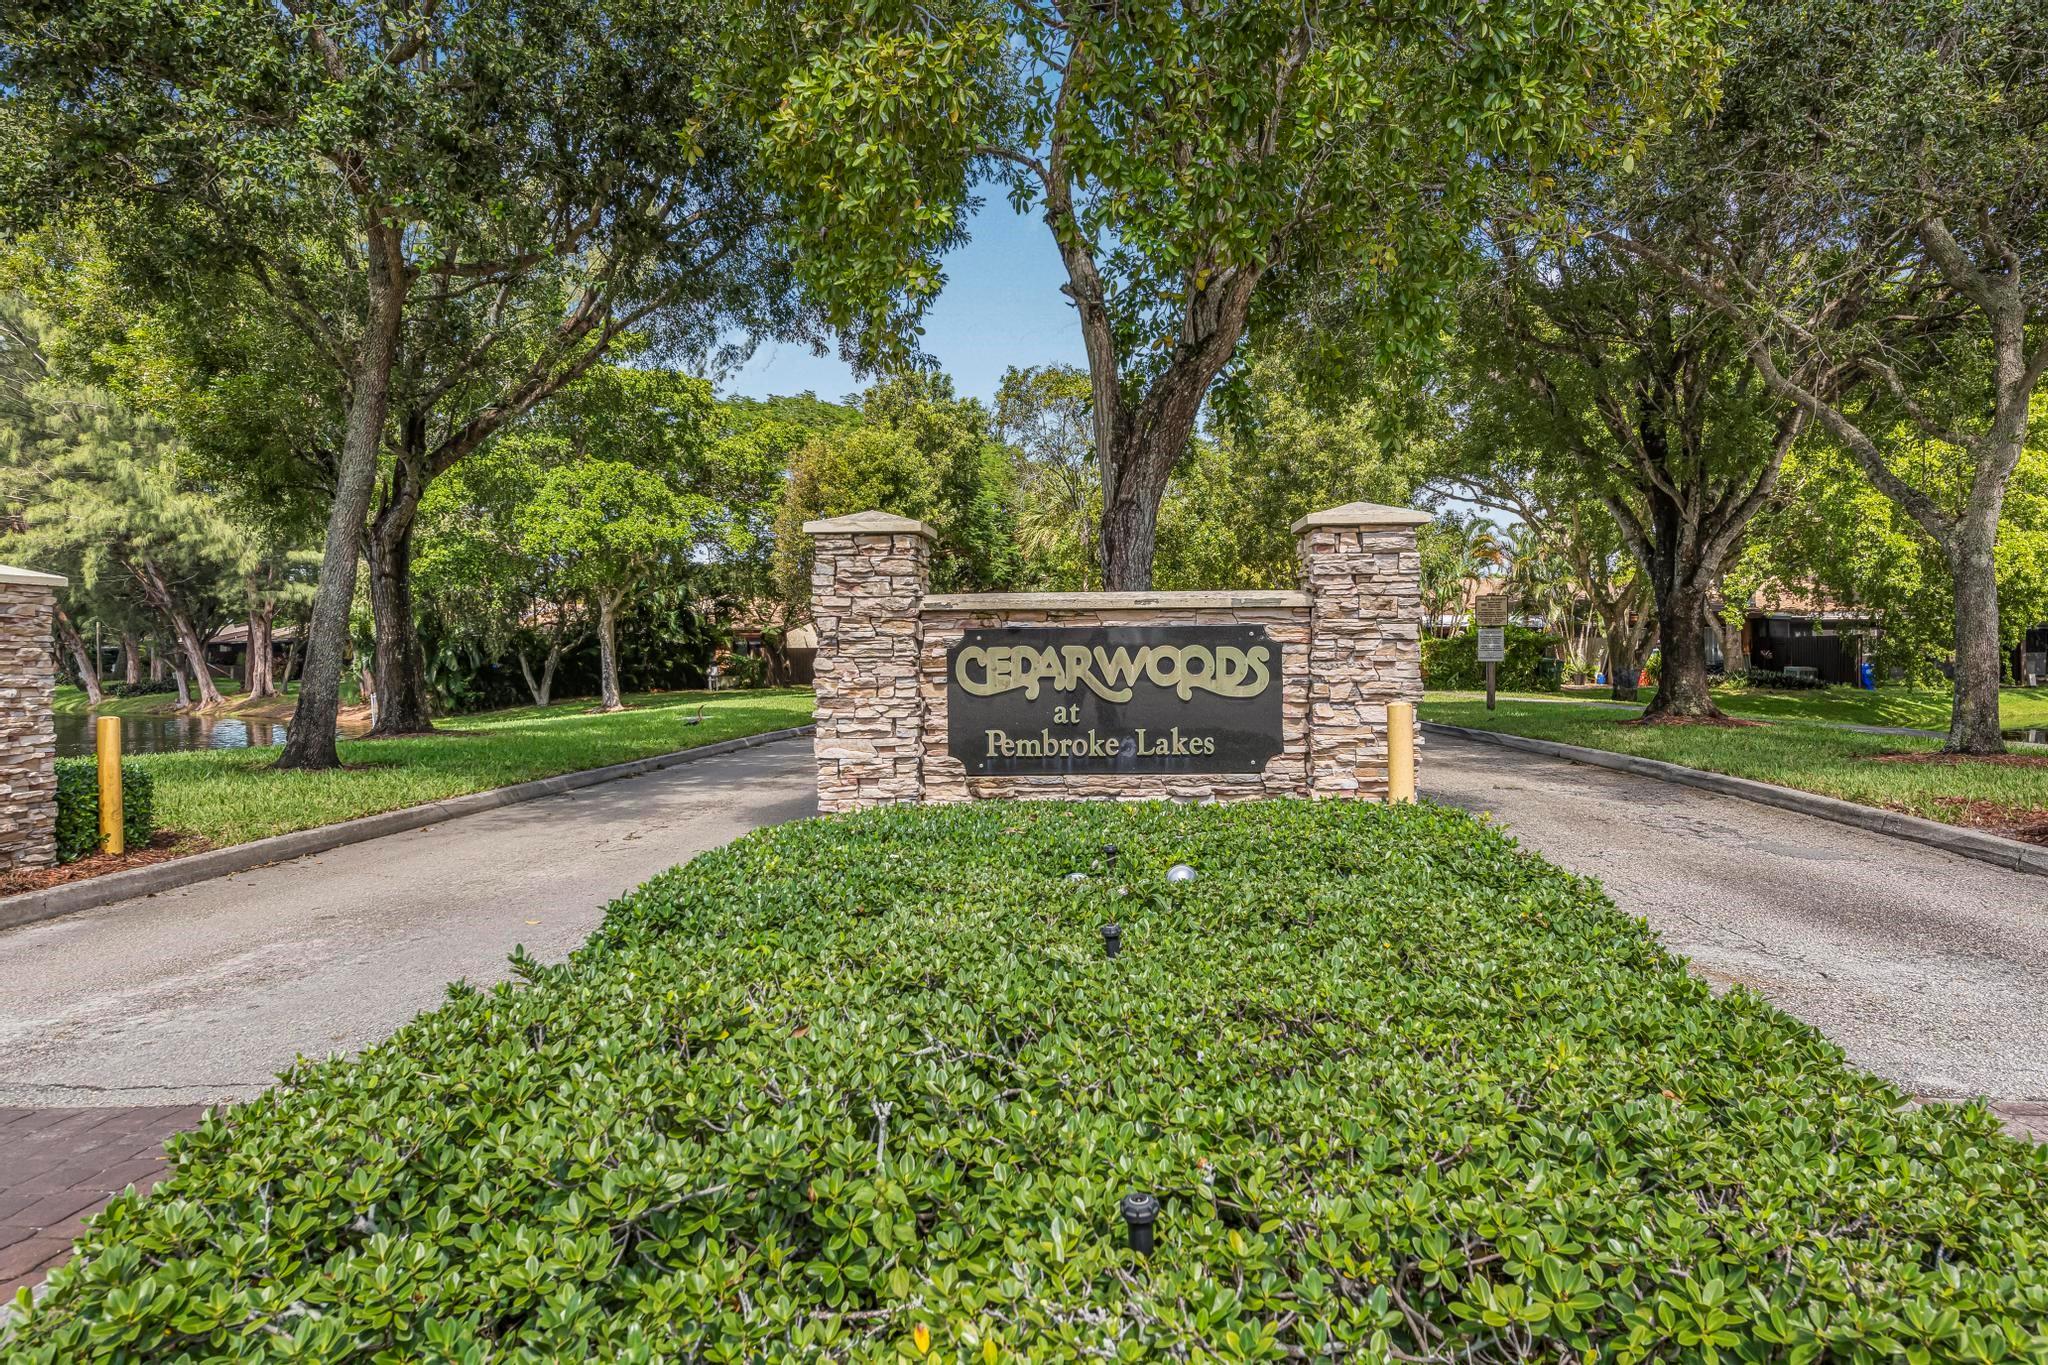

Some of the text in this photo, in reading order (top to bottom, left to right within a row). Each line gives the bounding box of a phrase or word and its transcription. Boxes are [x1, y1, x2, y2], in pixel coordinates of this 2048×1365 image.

[955, 645, 1270, 702] CEDARWOODS
[1053, 703, 1081, 724] at
[985, 727, 1215, 757] Pembroke Lakes
